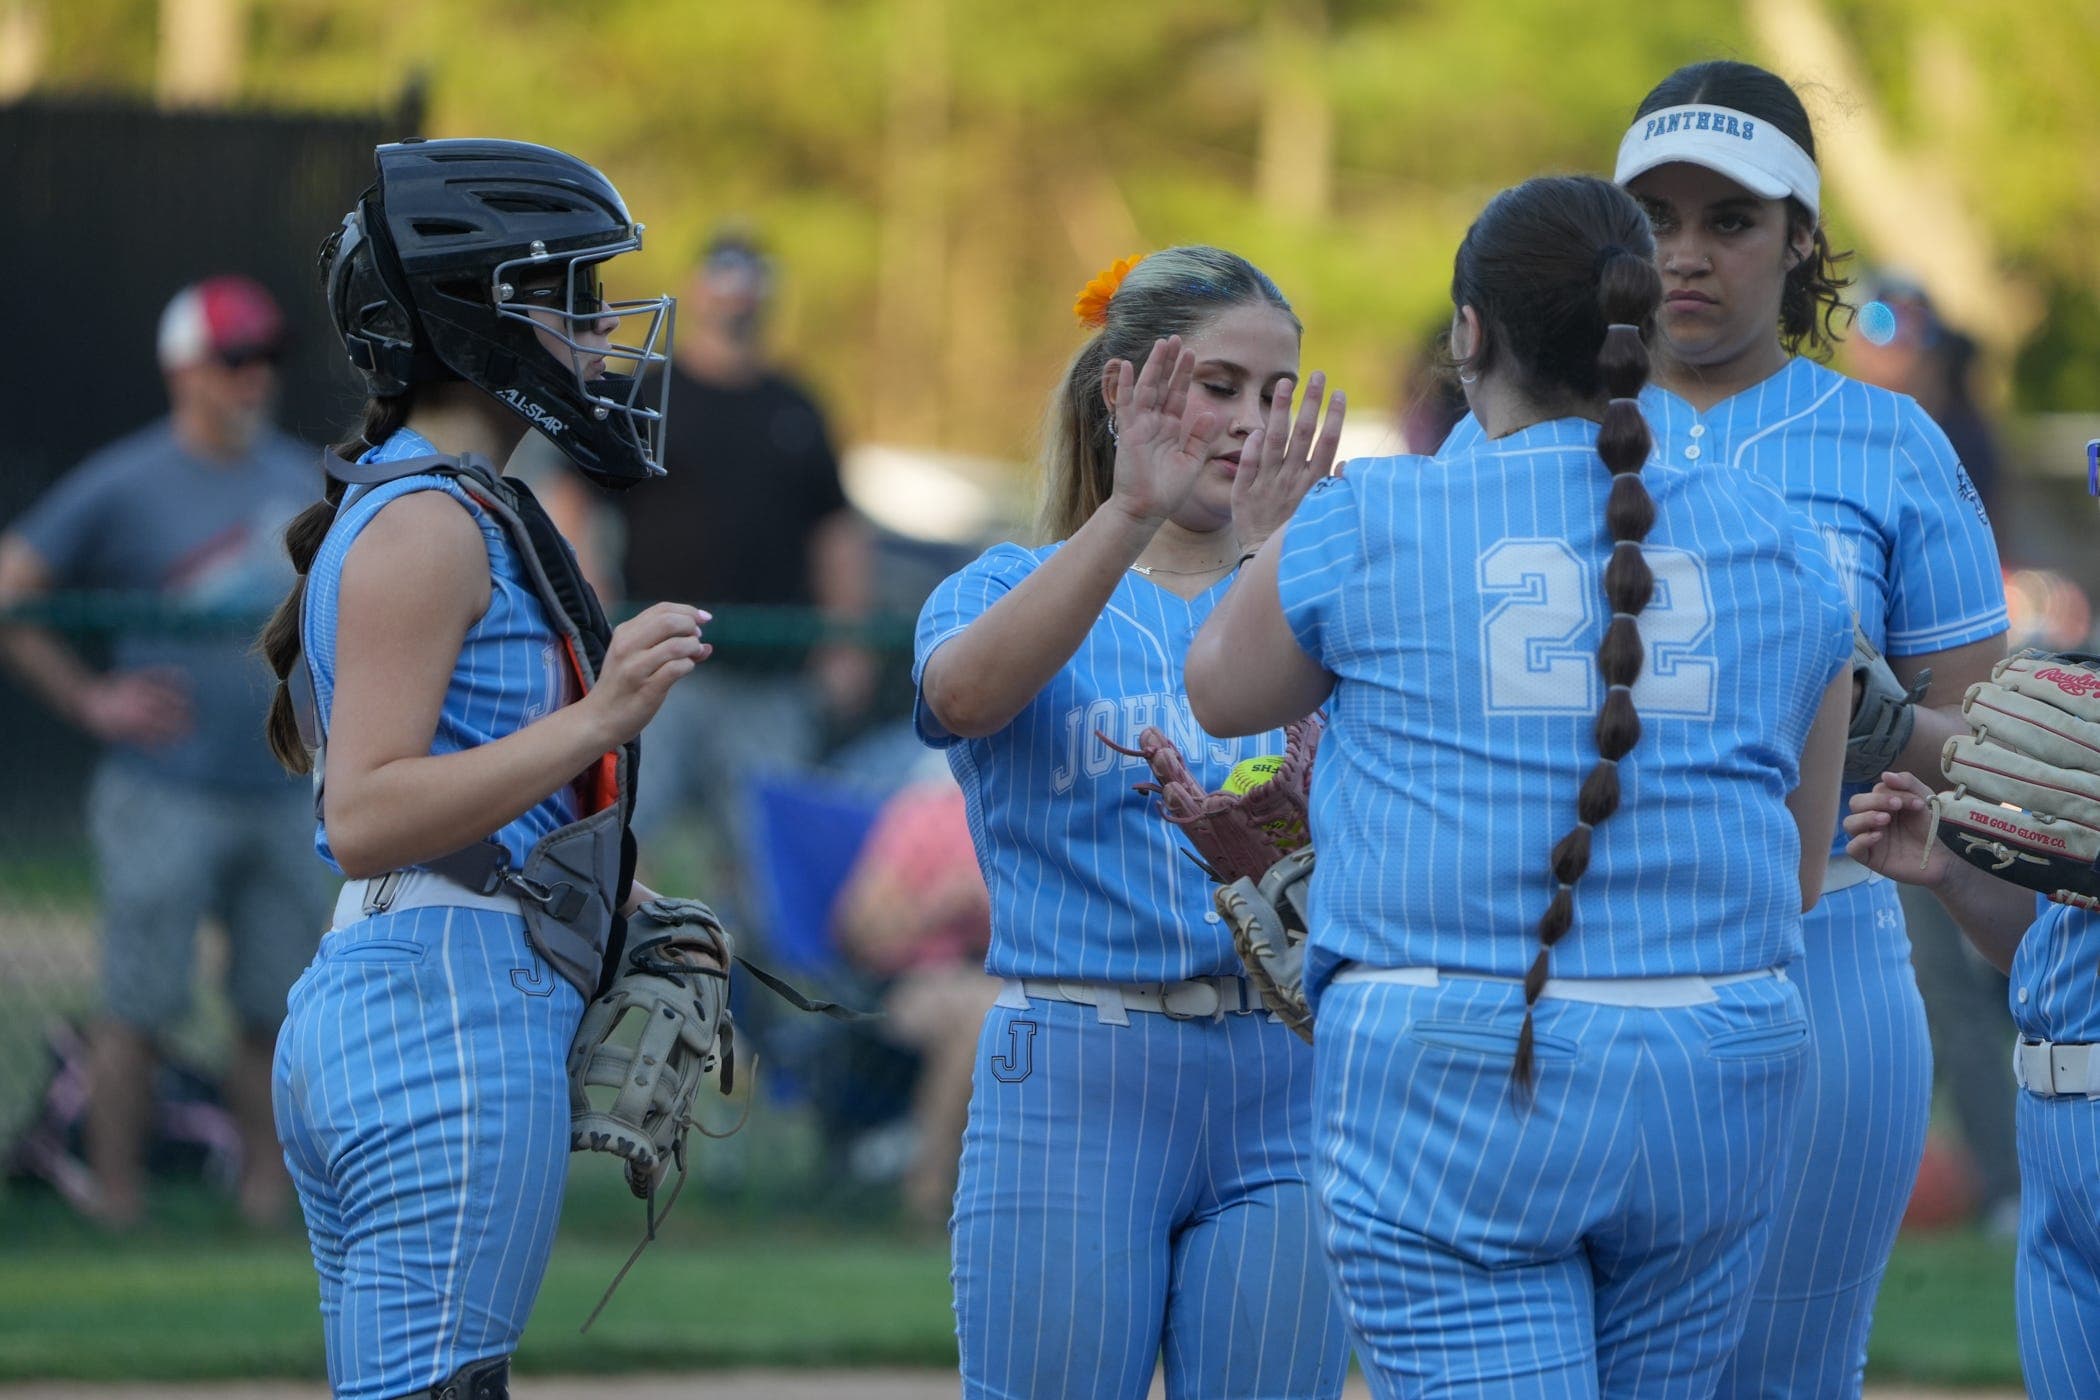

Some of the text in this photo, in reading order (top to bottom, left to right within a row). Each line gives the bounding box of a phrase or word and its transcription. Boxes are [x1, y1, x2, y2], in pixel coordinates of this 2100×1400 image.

[1644, 111, 1754, 141] PANTHERS
[495, 388, 563, 437] ALL-STAR
[1476, 537, 1719, 722] 22
[1052, 692, 1287, 796] JOHN
[1969, 811, 2067, 849] THE GOLD GLOVE CO.
[991, 1020, 1037, 1083] J
